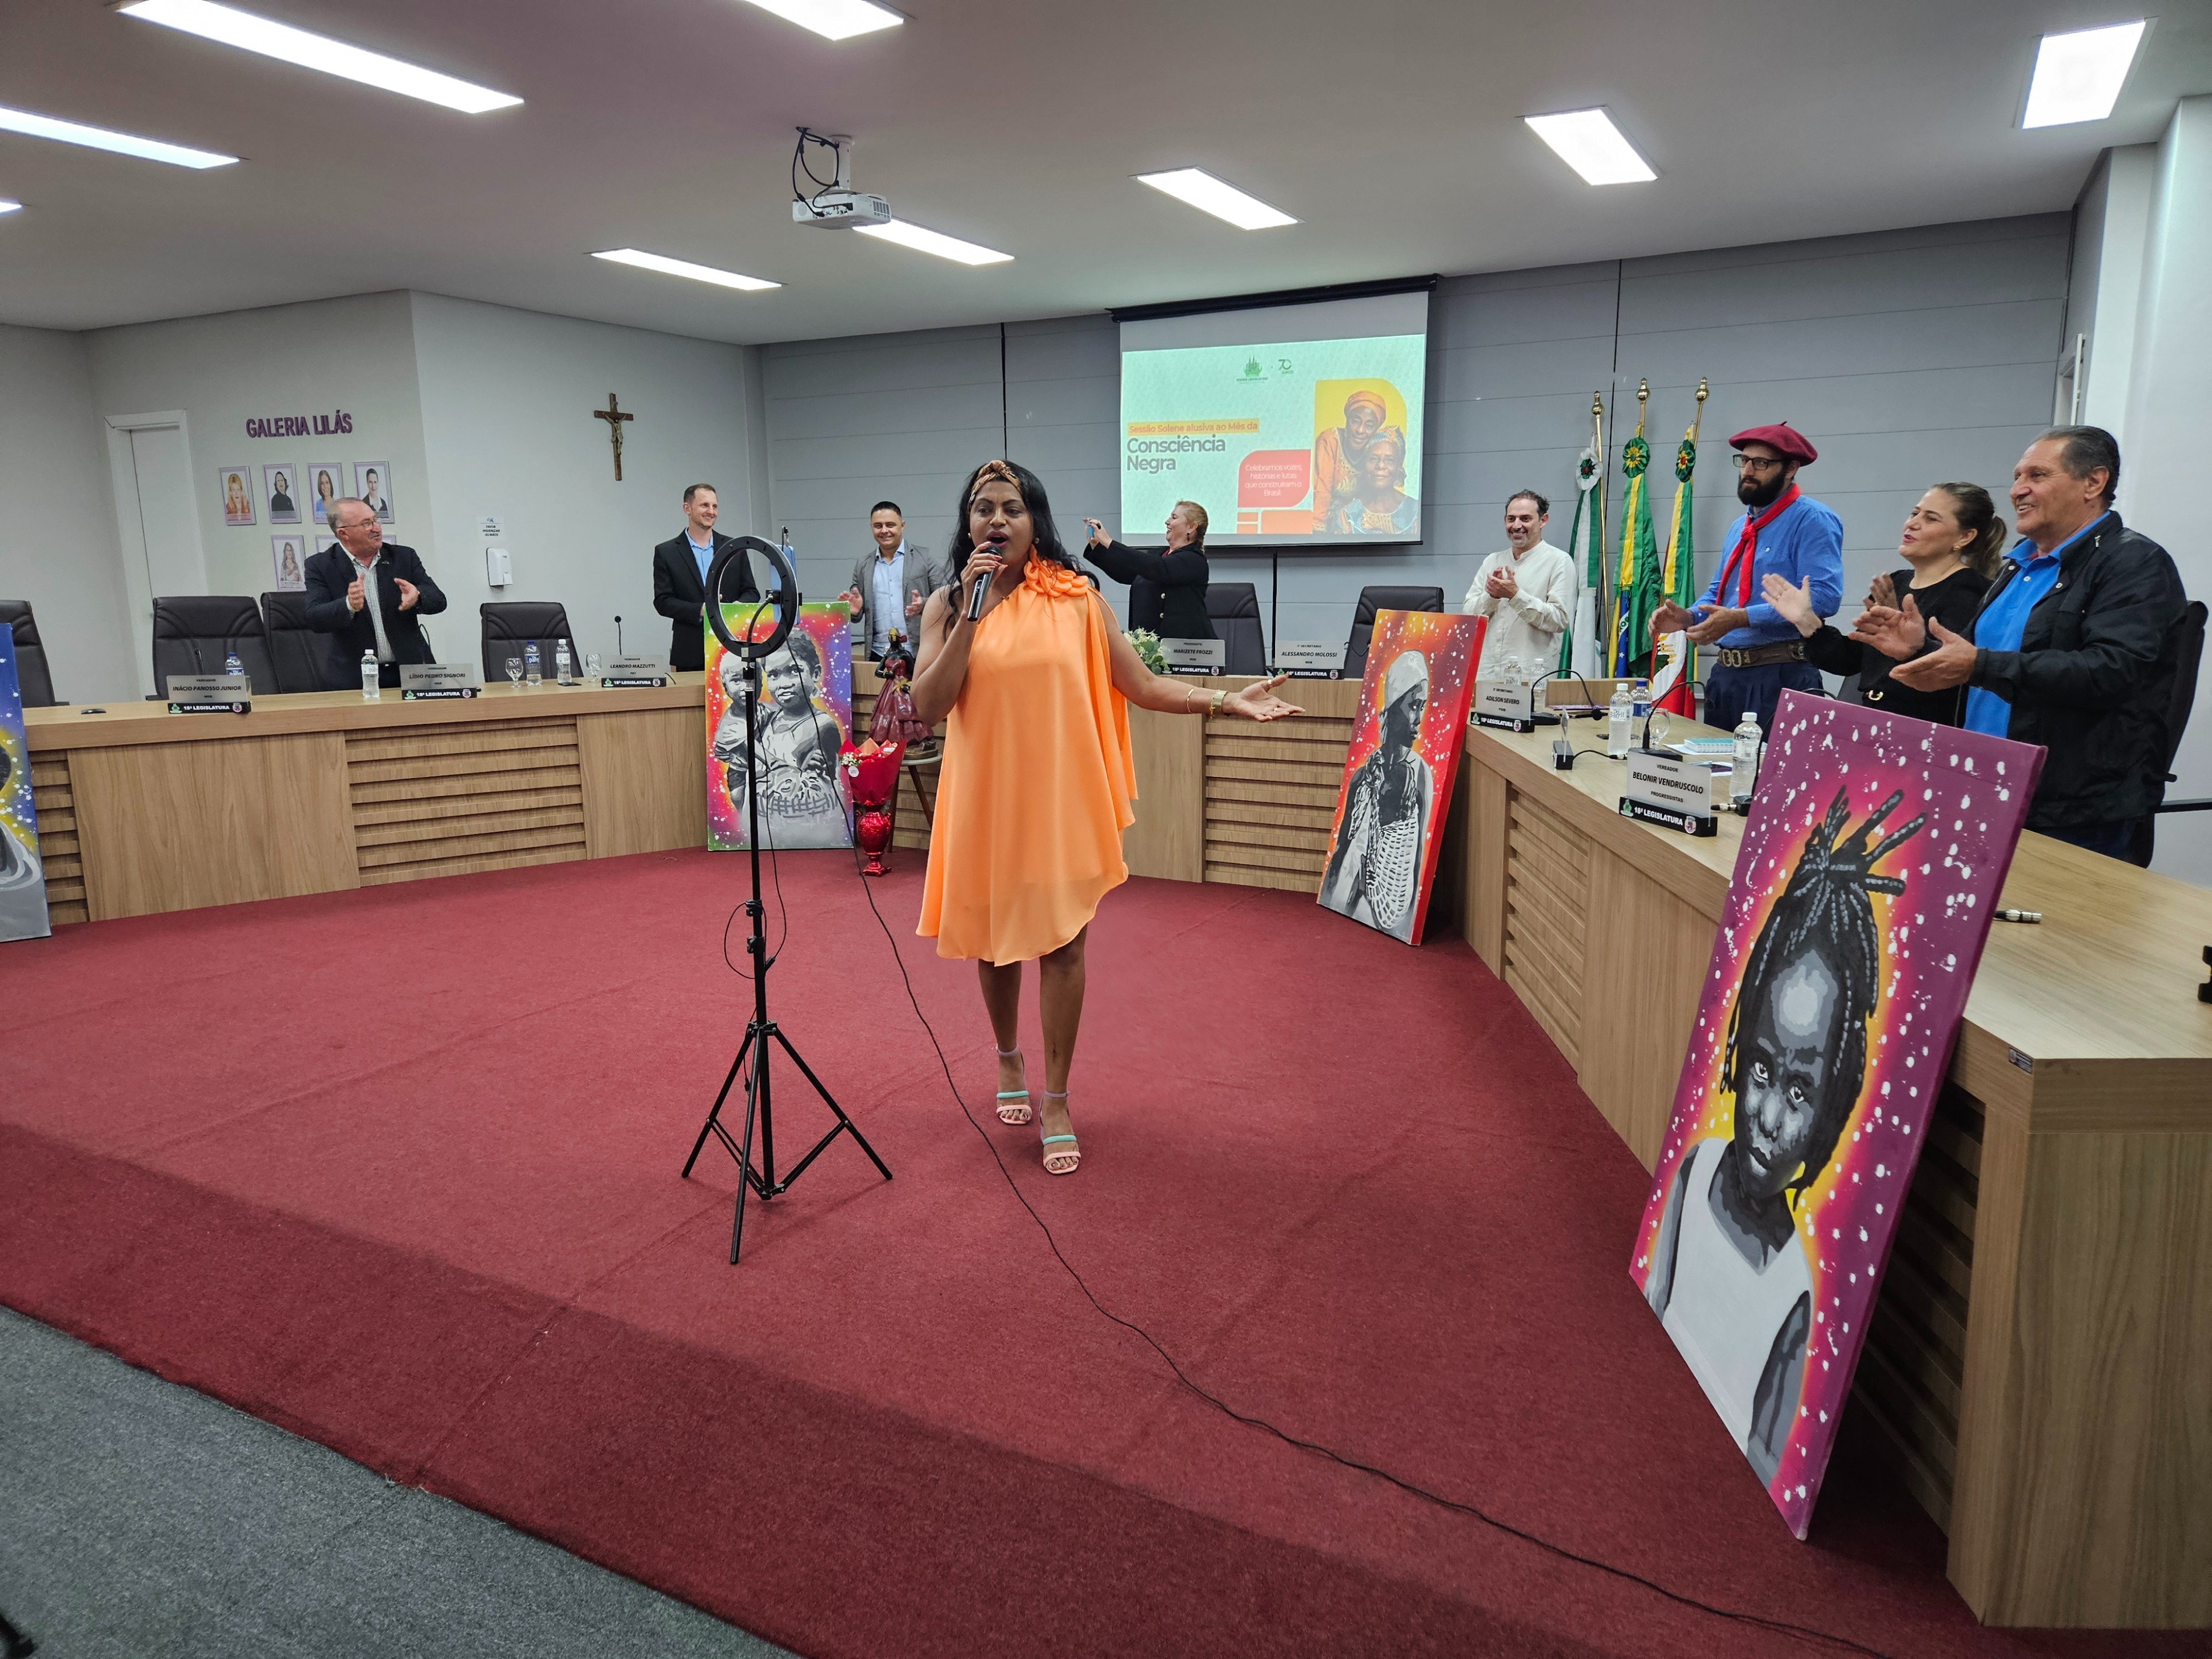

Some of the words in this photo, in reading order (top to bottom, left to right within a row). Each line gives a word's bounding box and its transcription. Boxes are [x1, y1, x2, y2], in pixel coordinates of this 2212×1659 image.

[246, 416, 310, 438] GALERIA
[312, 410, 352, 435] LILÁS
[1129, 424, 1156, 433] Sessão
[1187, 423, 1215, 432] alusiva
[1127, 434, 1226, 454] Consciência
[1127, 455, 1176, 474] Negra
[1487, 718, 1513, 727] LEGISLATURA
[1657, 764, 1678, 772] VEREADOR
[1633, 771, 1657, 784] BELONIR
[1658, 777, 1704, 794] VENDRUSCOLO
[1650, 791, 1684, 803] PROGRESSISTAS
[1644, 809, 1683, 826] LEGISLATURA
